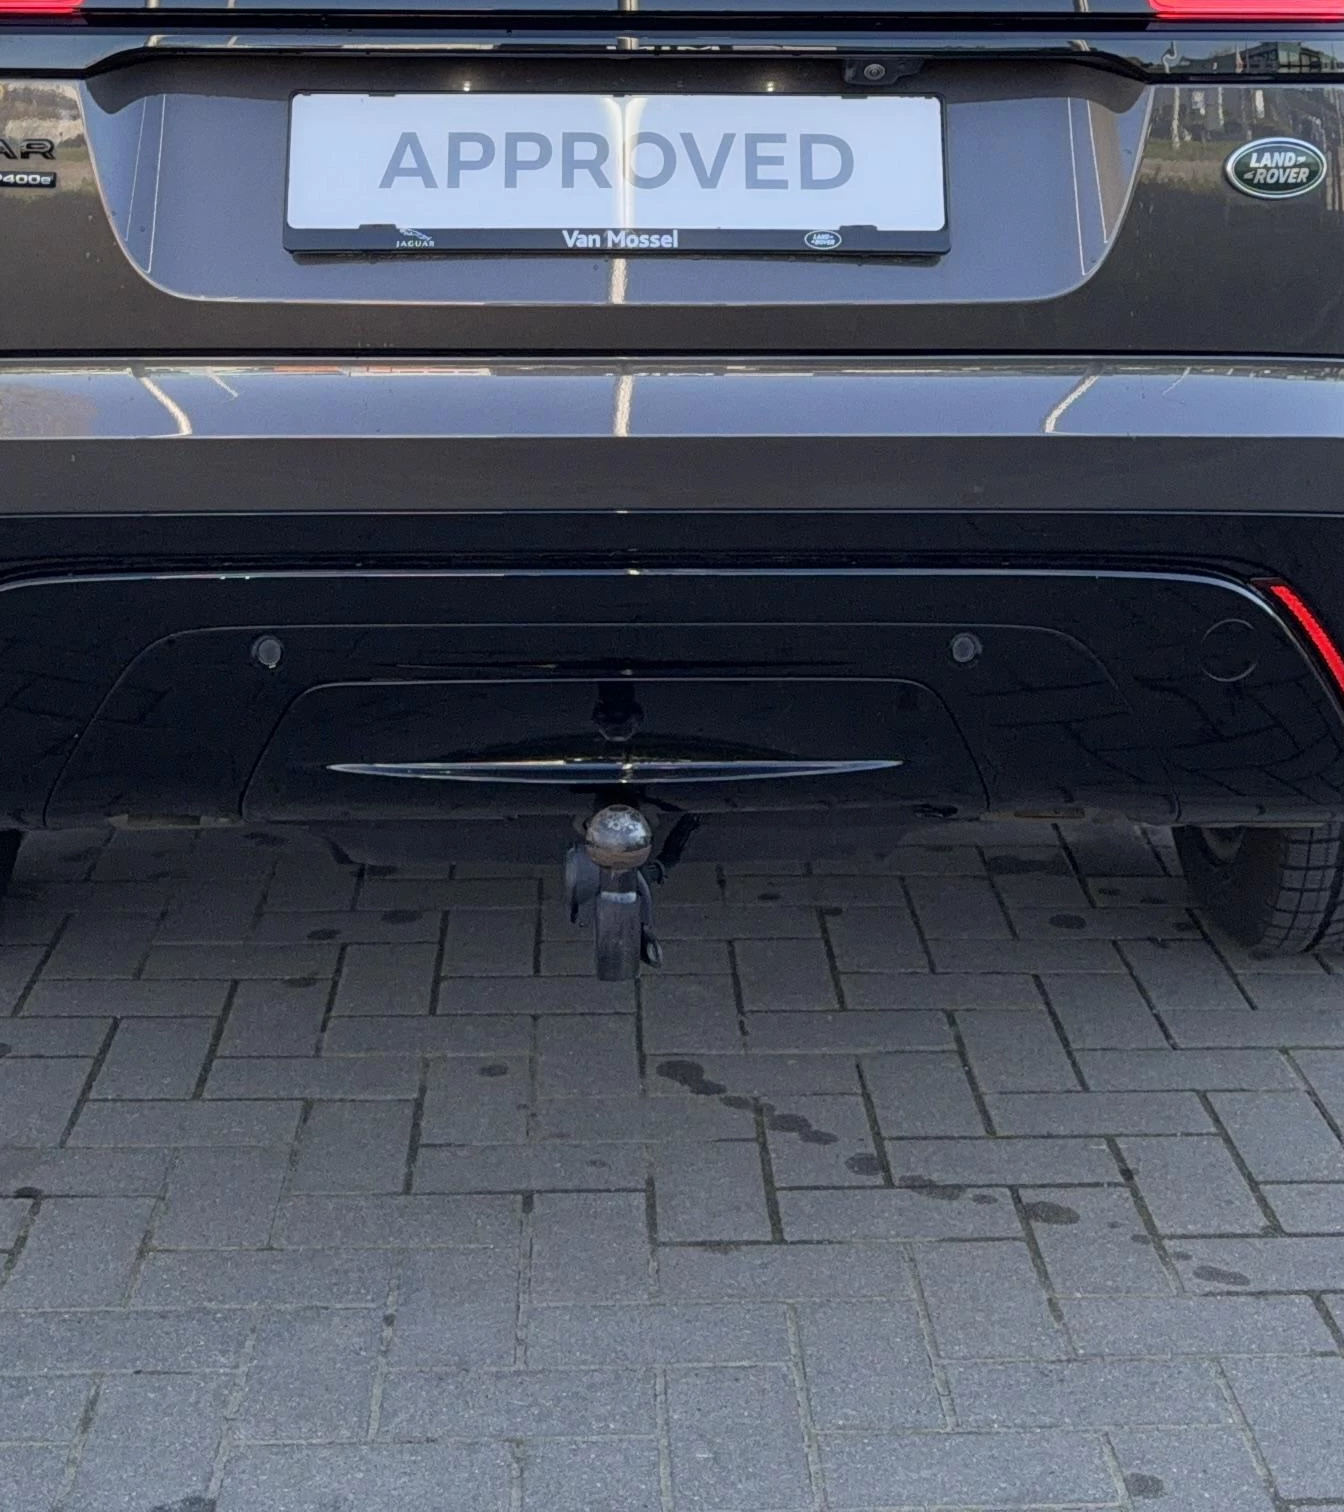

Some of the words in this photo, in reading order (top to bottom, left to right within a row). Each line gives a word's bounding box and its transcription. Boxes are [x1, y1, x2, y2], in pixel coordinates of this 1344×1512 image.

[378, 130, 855, 191] APPROVED
[1249, 151, 1297, 168] LAND
[1253, 167, 1310, 184] ROVER
[396, 240, 435, 248] JAGUAR
[562, 230, 601, 248] Van
[606, 229, 679, 248] Mossel
